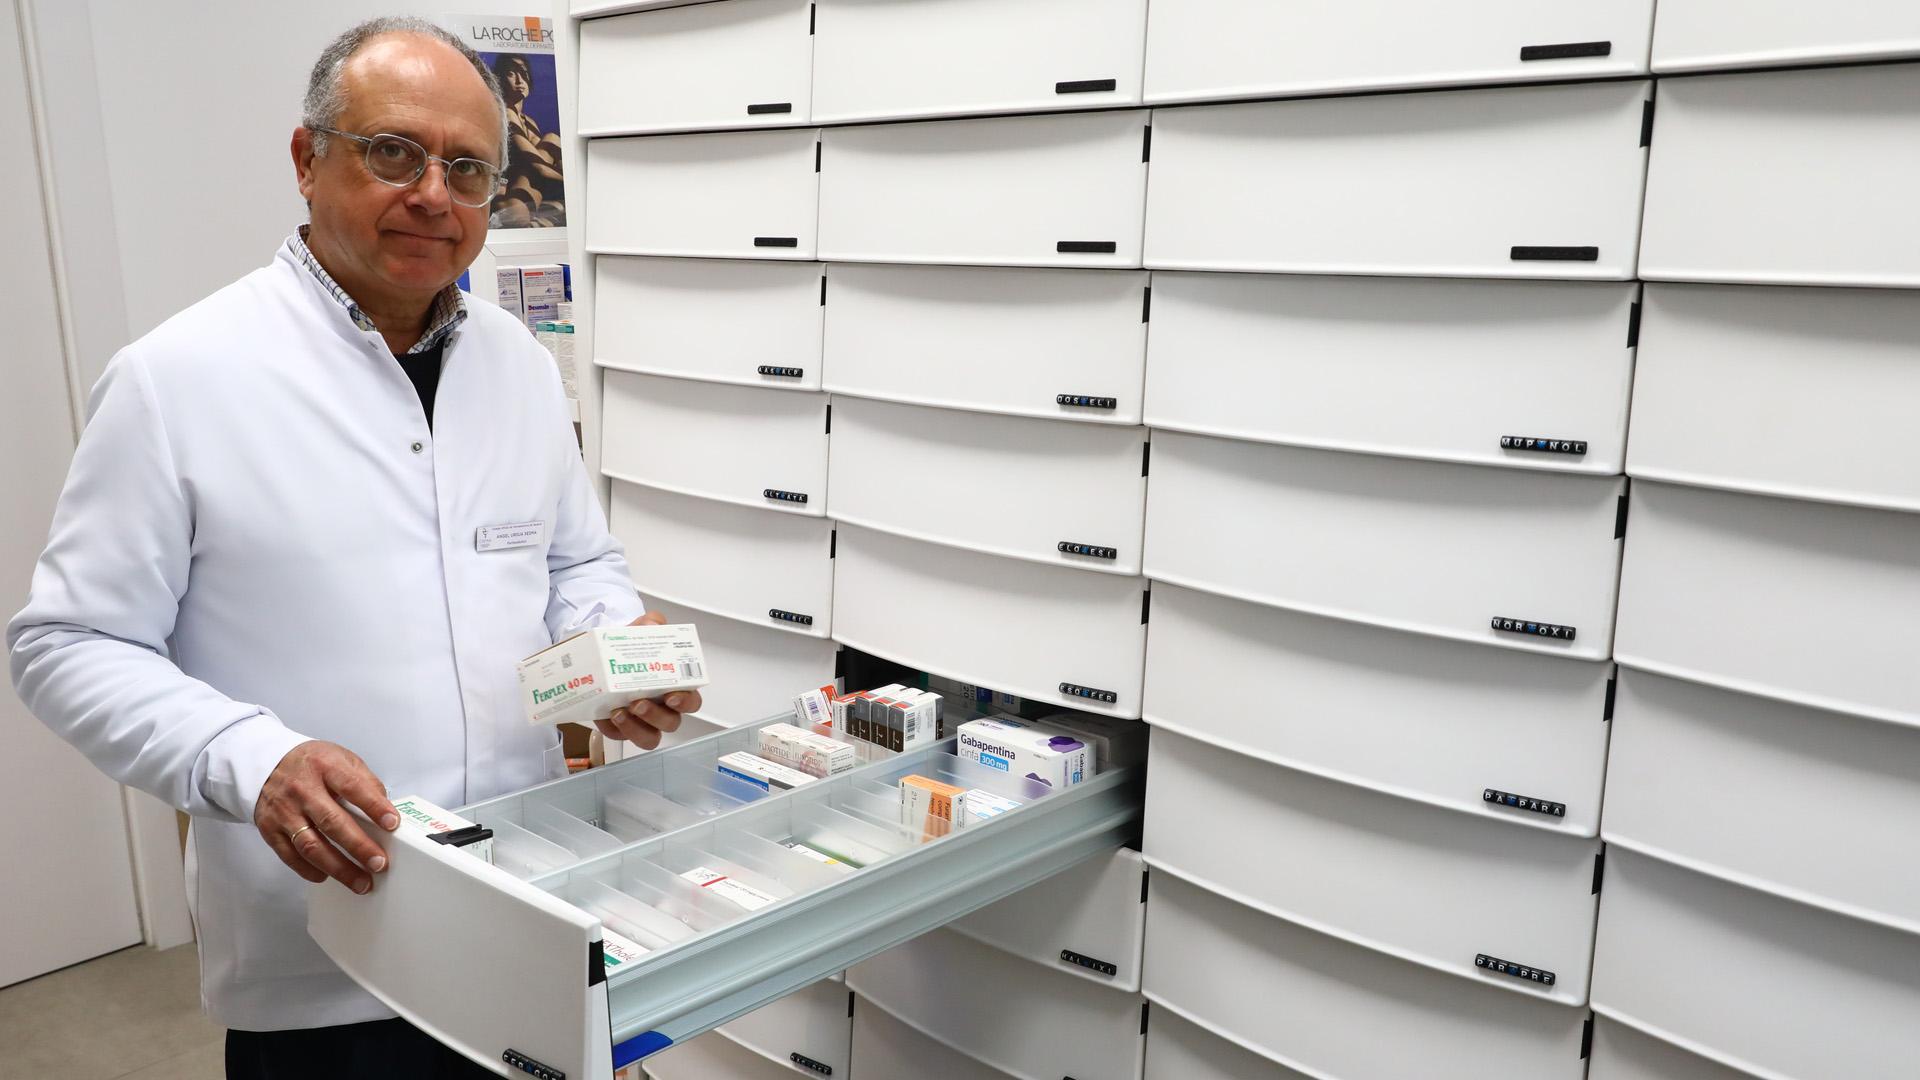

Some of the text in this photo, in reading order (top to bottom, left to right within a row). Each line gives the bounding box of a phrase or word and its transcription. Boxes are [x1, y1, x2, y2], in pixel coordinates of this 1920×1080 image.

[472, 26, 491, 40] LA
[492, 27, 539, 42] ROCHE
[1493, 618, 1523, 631] NOR
[649, 662, 661, 671] 40
[661, 662, 675, 673] mg
[568, 678, 580, 689] 40
[961, 733, 1016, 760] Gabapentina
[981, 755, 995, 767] 300
[1519, 800, 1561, 816] PARA
[1477, 958, 1551, 984] PAR PRE
